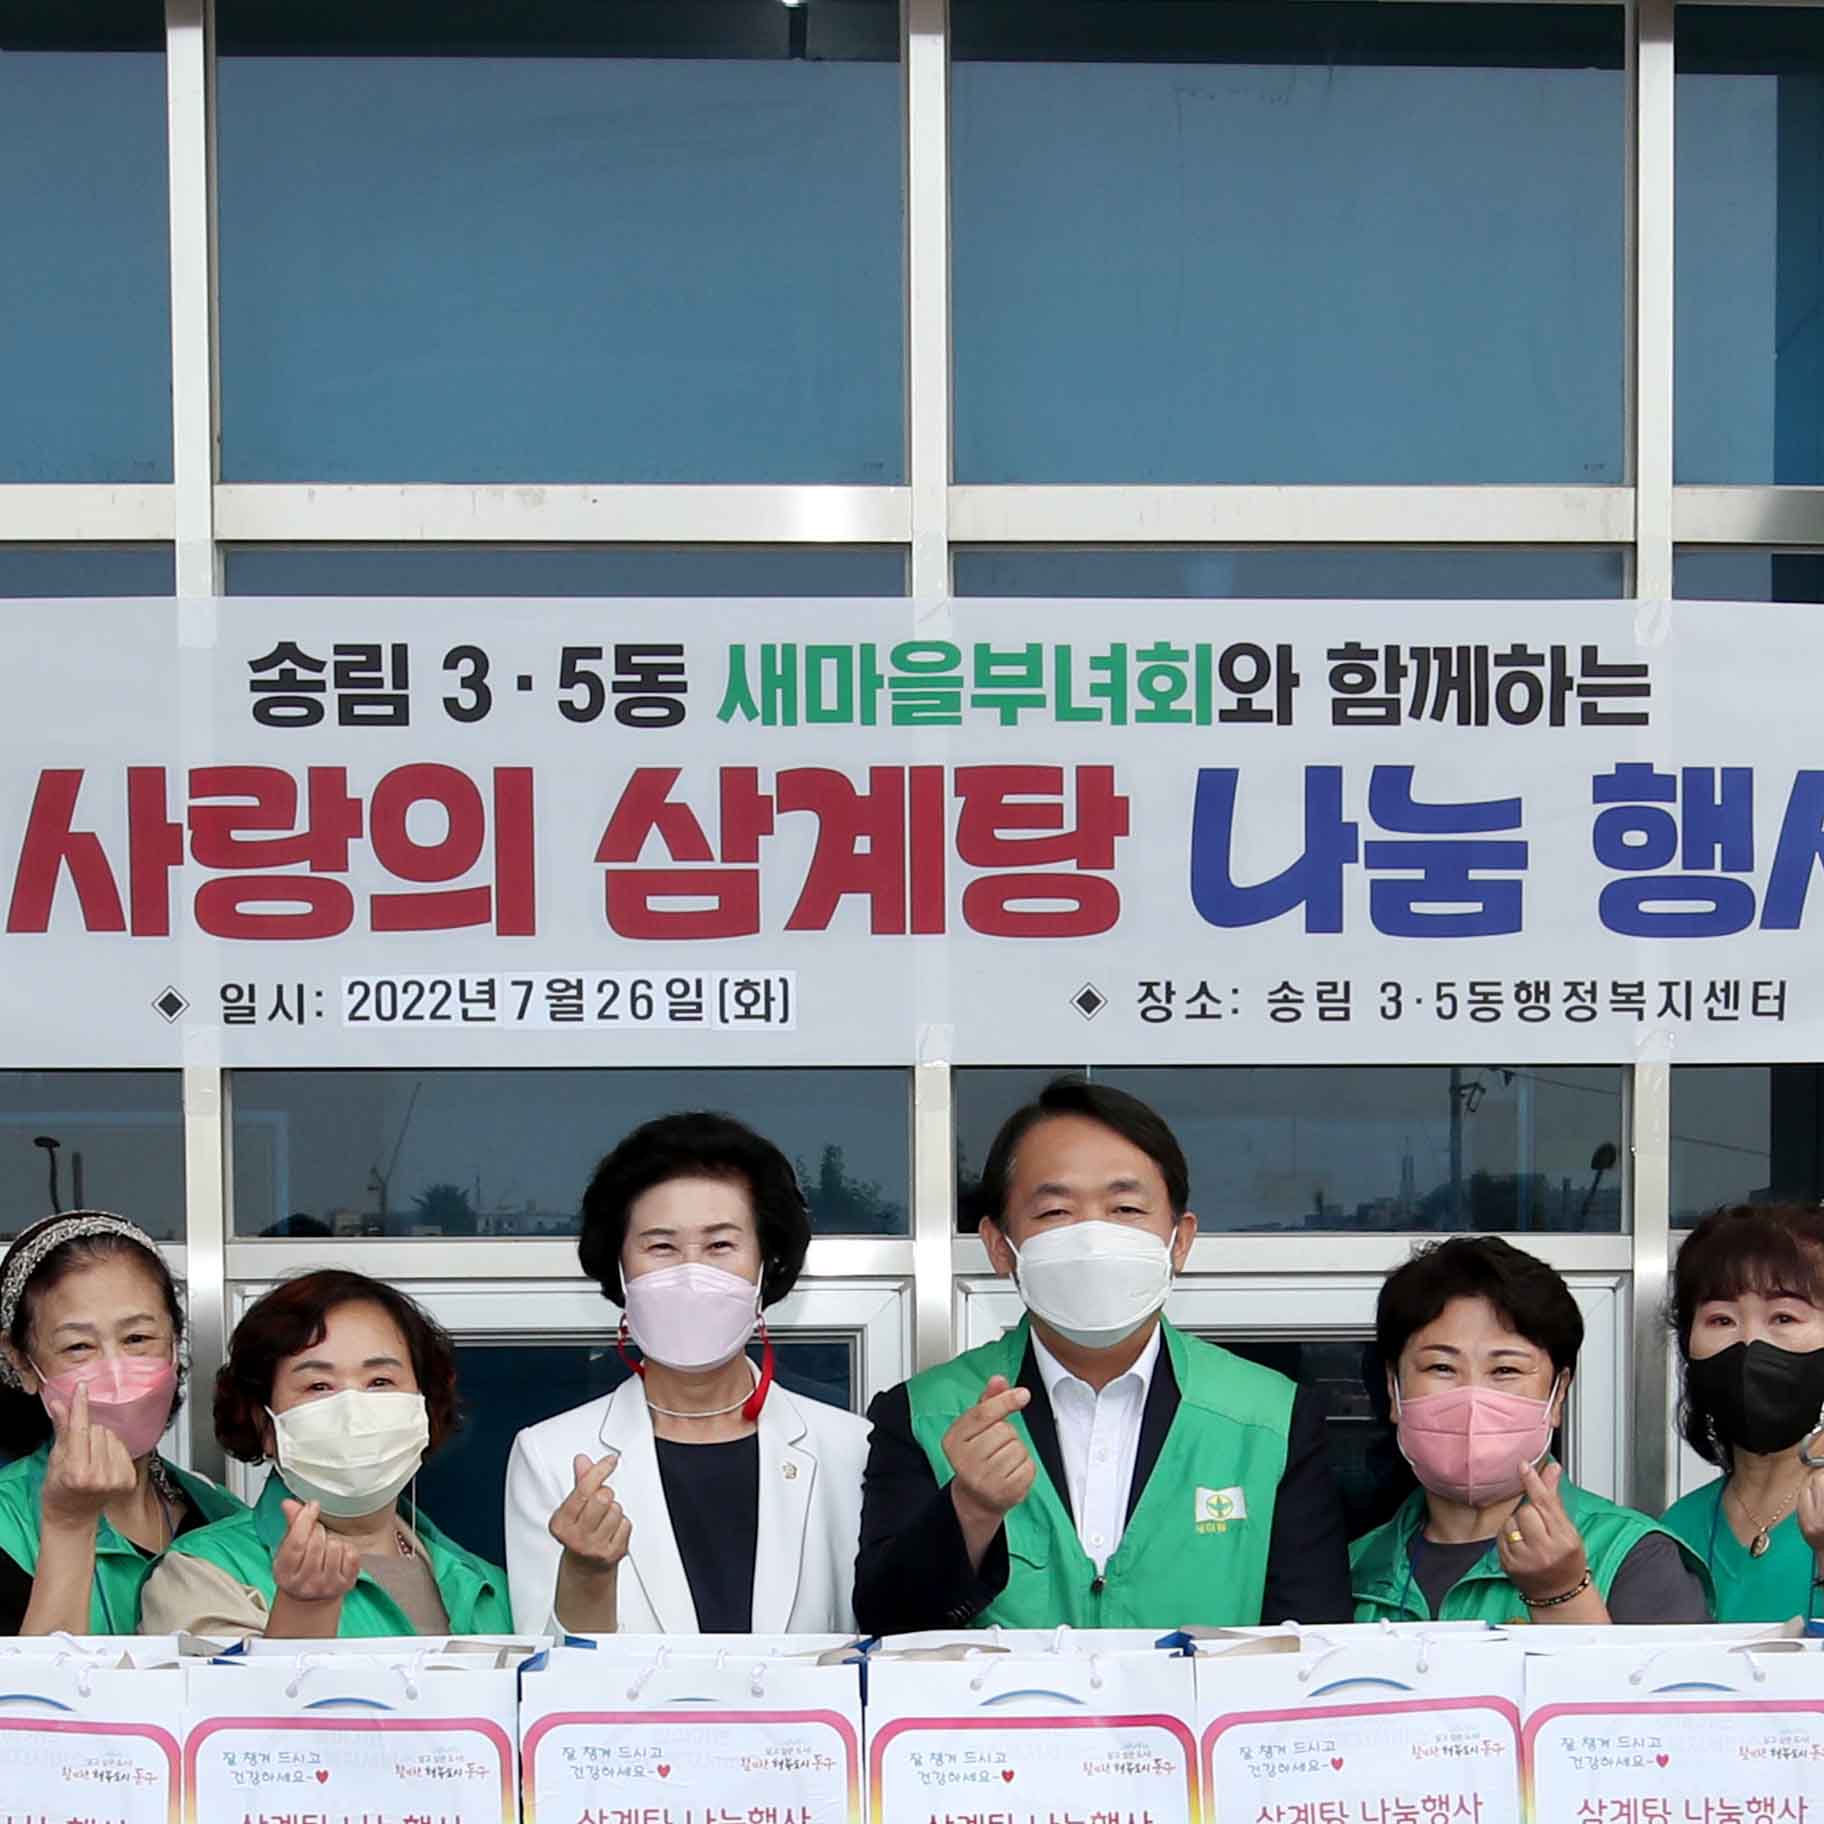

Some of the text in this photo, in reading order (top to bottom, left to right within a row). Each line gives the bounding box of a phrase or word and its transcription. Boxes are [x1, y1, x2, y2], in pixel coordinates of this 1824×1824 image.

[248, 641, 410, 728] 송림
[716, 640, 1300, 727] 새마을부녀회와
[1326, 641, 1651, 727] 함께하는
[6, 763, 536, 940] 사랑의
[594, 765, 1129, 940] 삼계탕
[1190, 765, 1528, 938] 나눔
[220, 983, 323, 1025] 일시:
[1137, 980, 1239, 1023] 장소:
[1267, 980, 1350, 1023] 송림
